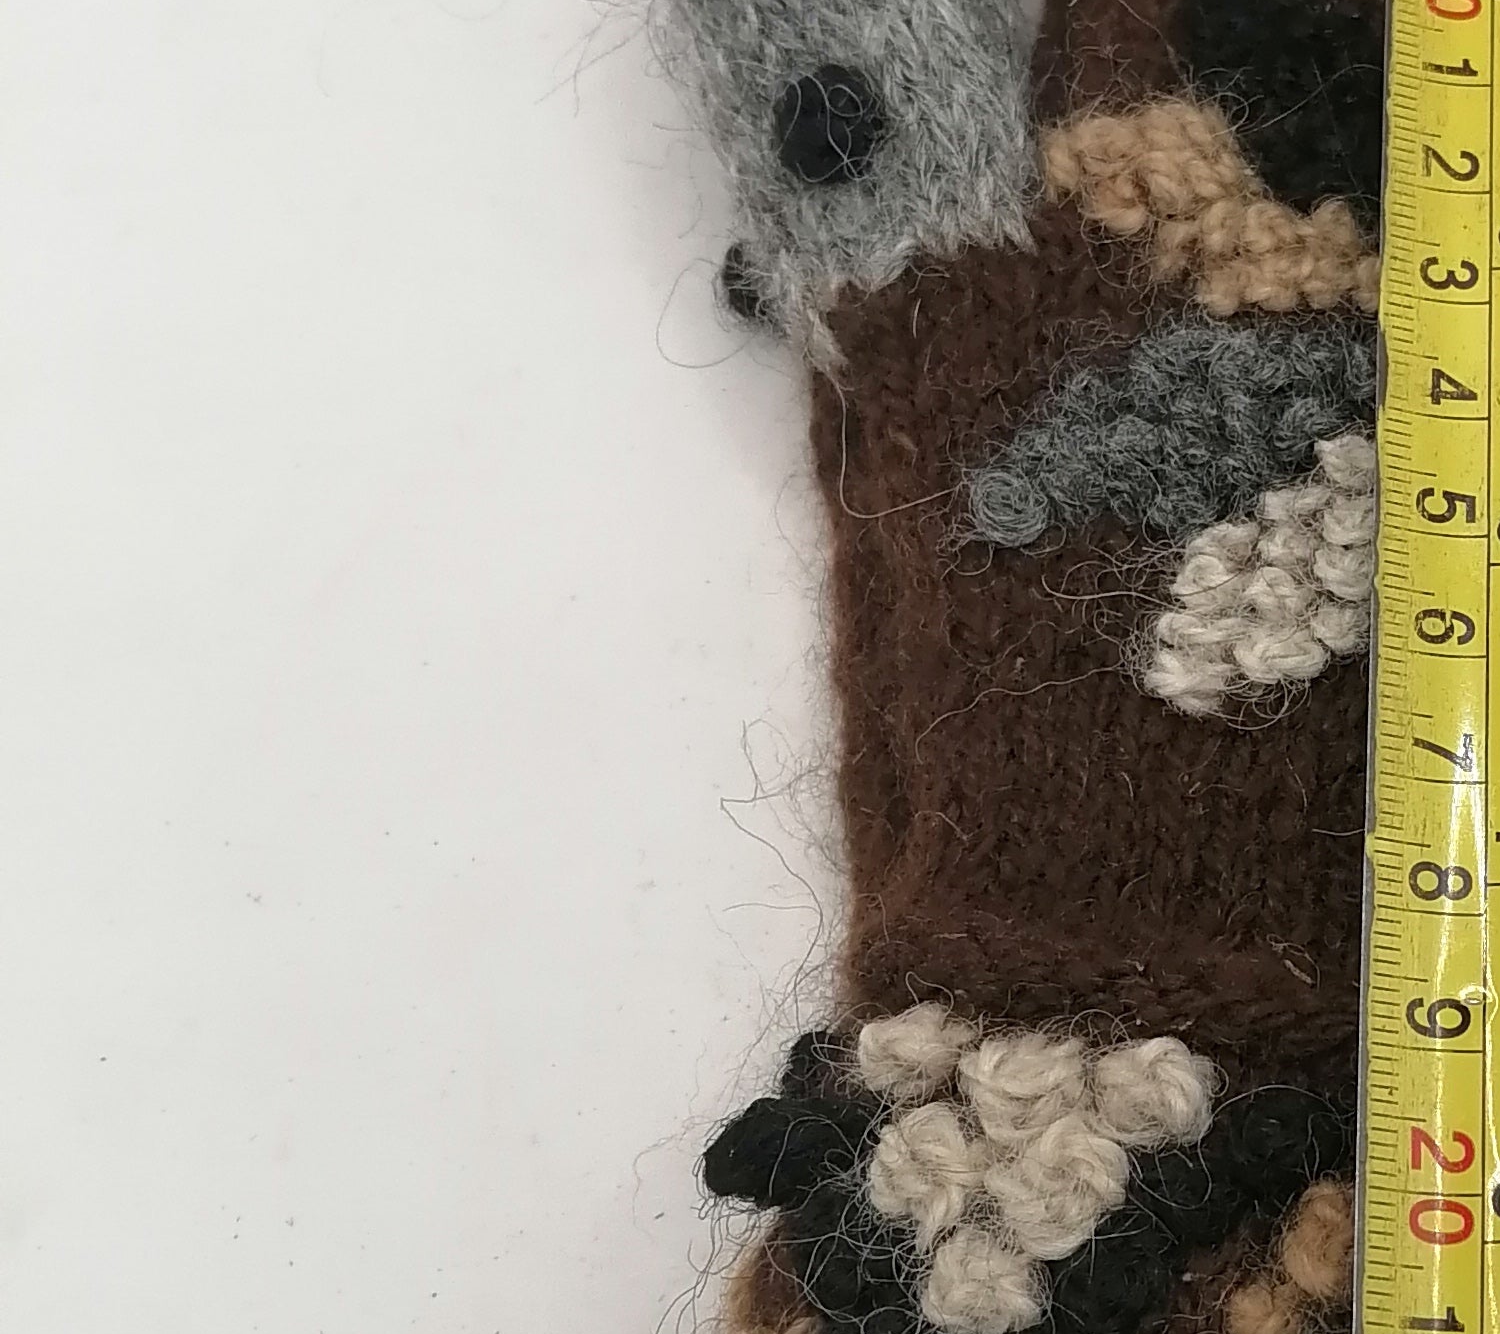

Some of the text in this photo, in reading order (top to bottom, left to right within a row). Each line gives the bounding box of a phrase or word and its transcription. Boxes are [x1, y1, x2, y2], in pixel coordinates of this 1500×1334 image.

[1422, 58, 1478, 77] 1
[1422, 144, 1480, 182] 2
[1419, 256, 1479, 291] 3
[1430, 367, 1478, 405] 4
[1416, 487, 1476, 524] 5
[1414, 608, 1476, 646] 6
[1412, 733, 1474, 772] 7
[1408, 861, 1473, 901] 8
[1405, 997, 1471, 1039] 9
[1409, 1125, 1475, 1245] 20
[1402, 1306, 1465, 1333] 1
